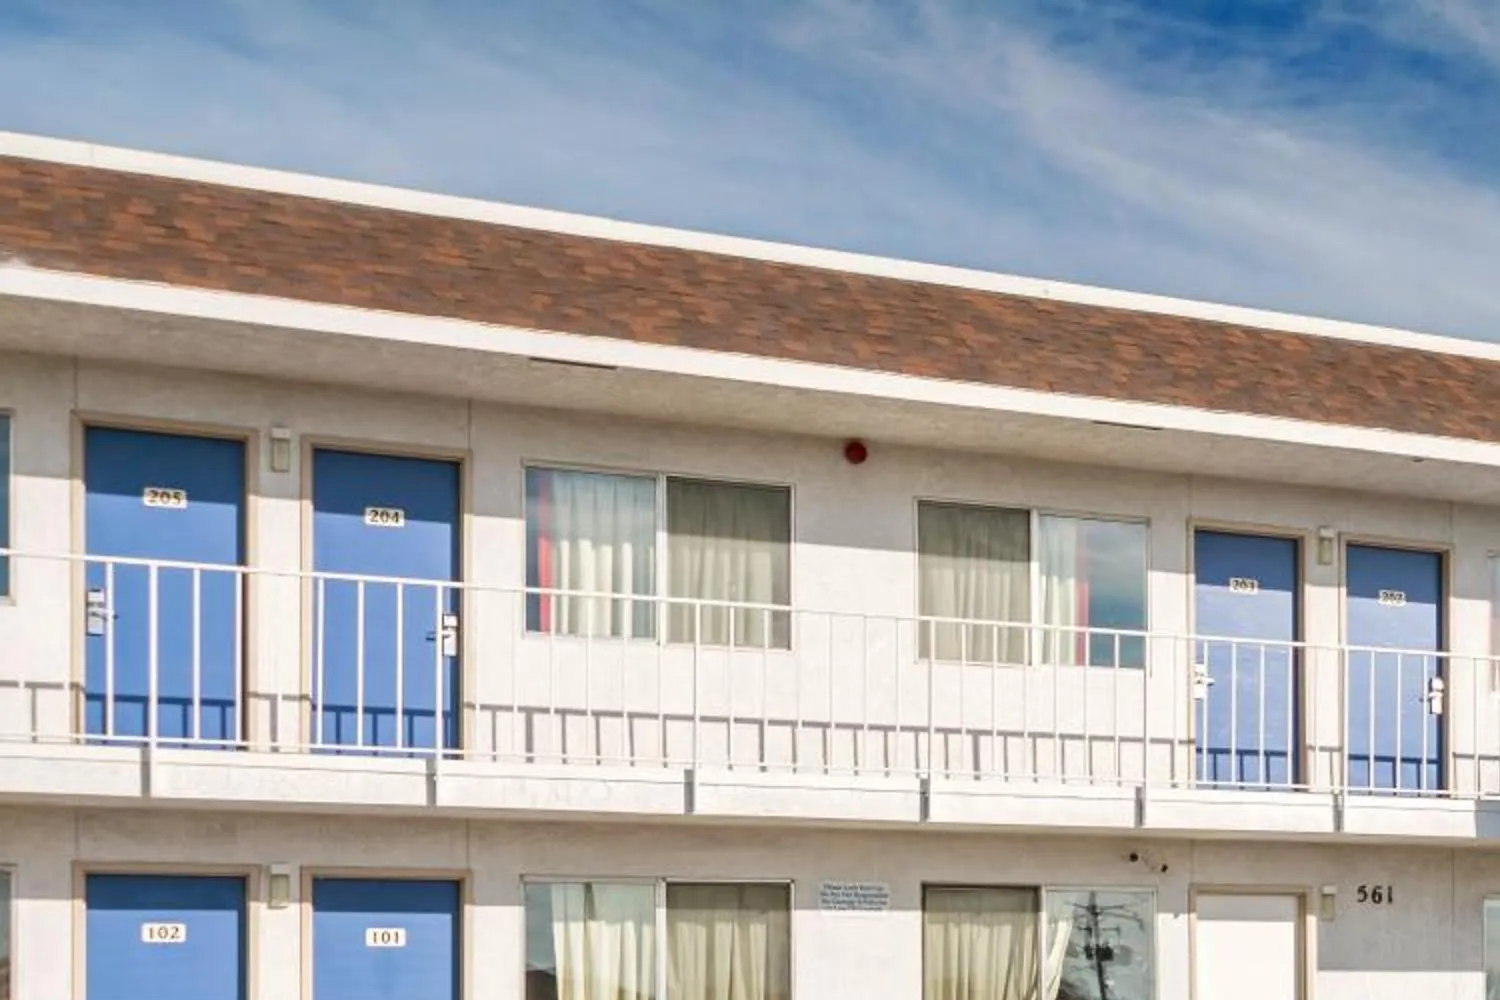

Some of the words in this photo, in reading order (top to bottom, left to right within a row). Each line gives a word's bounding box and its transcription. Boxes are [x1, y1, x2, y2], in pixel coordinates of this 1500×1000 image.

[147, 489, 182, 504] 205
[369, 509, 399, 523] 204
[1357, 885, 1393, 904] 561
[149, 925, 181, 940] 102
[373, 931, 399, 944] 101
